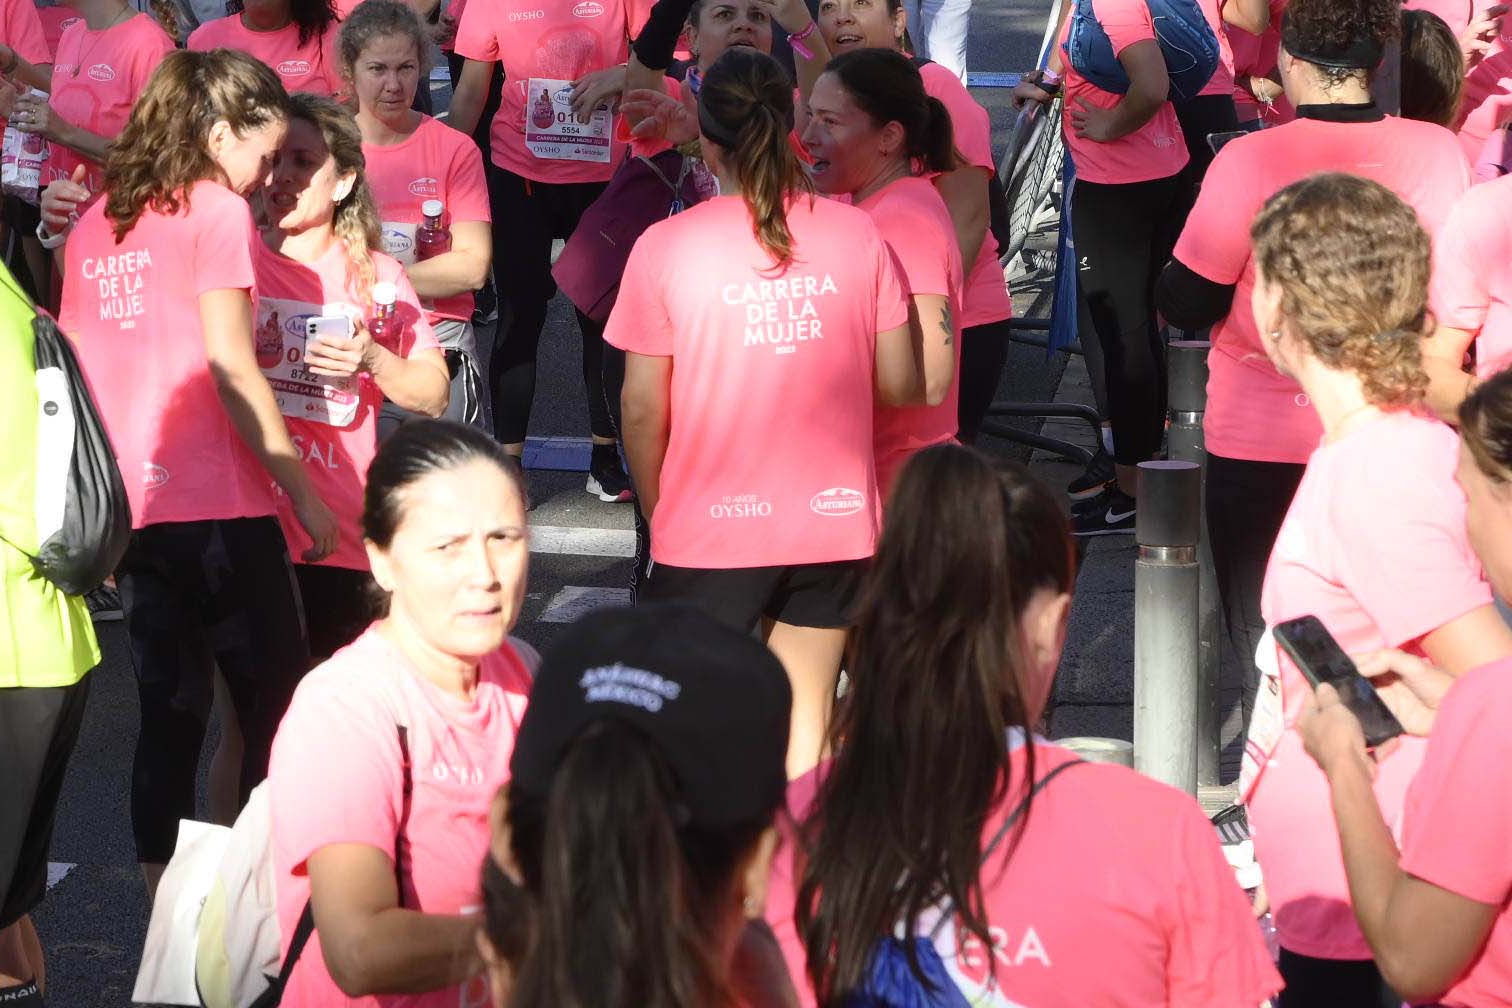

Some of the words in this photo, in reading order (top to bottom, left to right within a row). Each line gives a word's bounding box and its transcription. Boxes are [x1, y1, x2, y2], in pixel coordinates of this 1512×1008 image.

[508, 8, 545, 22] OYSHO
[561, 126, 580, 134] 5554
[533, 145, 561, 154] OYSHO
[82, 248, 153, 280] CARRERA
[99, 276, 120, 298] DE
[123, 273, 144, 295] LA
[721, 273, 839, 305] CARRERA
[746, 301, 779, 325] DE
[787, 298, 818, 320] LA
[743, 319, 824, 347] MUJER
[710, 501, 772, 519] OYSHO
